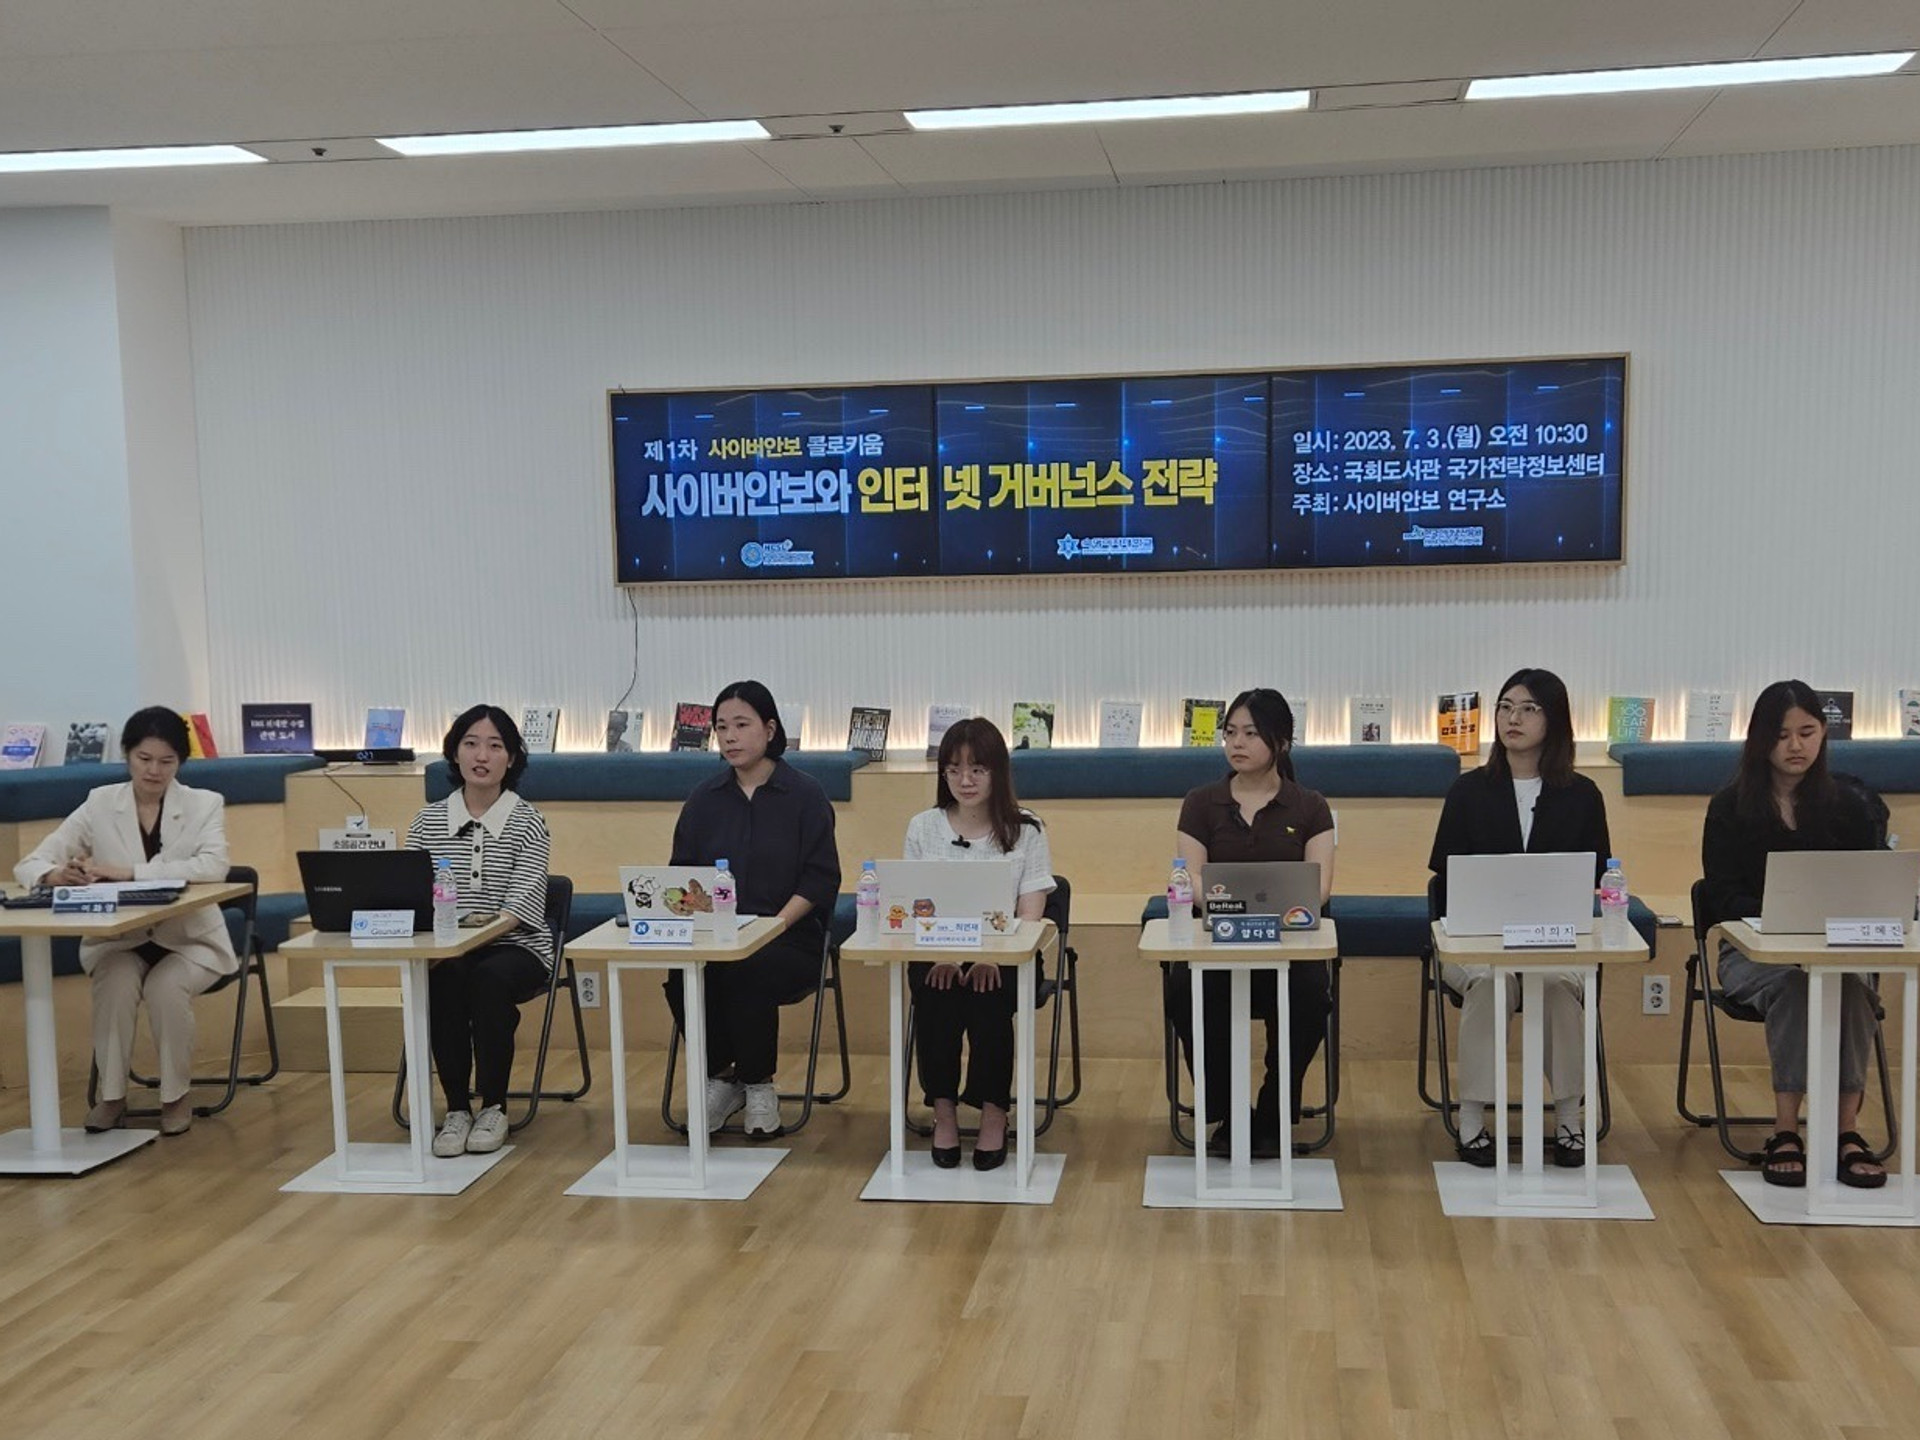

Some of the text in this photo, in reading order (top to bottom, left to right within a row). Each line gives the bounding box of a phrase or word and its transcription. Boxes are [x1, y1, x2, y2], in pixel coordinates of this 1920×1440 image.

[708, 436, 802, 460] 사이버안보
[806, 433, 884, 457] 콜로키움
[1292, 430, 1338, 453] 일시:
[1344, 430, 1396, 452] 2023.
[1487, 426, 1528, 448] 오전
[1535, 423, 1588, 444] 10:30
[1292, 453, 1605, 485] 장소: 국회도서관 국가전략정보센터
[641, 468, 852, 518] 사이버안보와
[988, 460, 1134, 510] 거버넌스
[1142, 458, 1218, 506] 전략
[1292, 487, 1507, 516] 주최: 사이버안보 연구소
